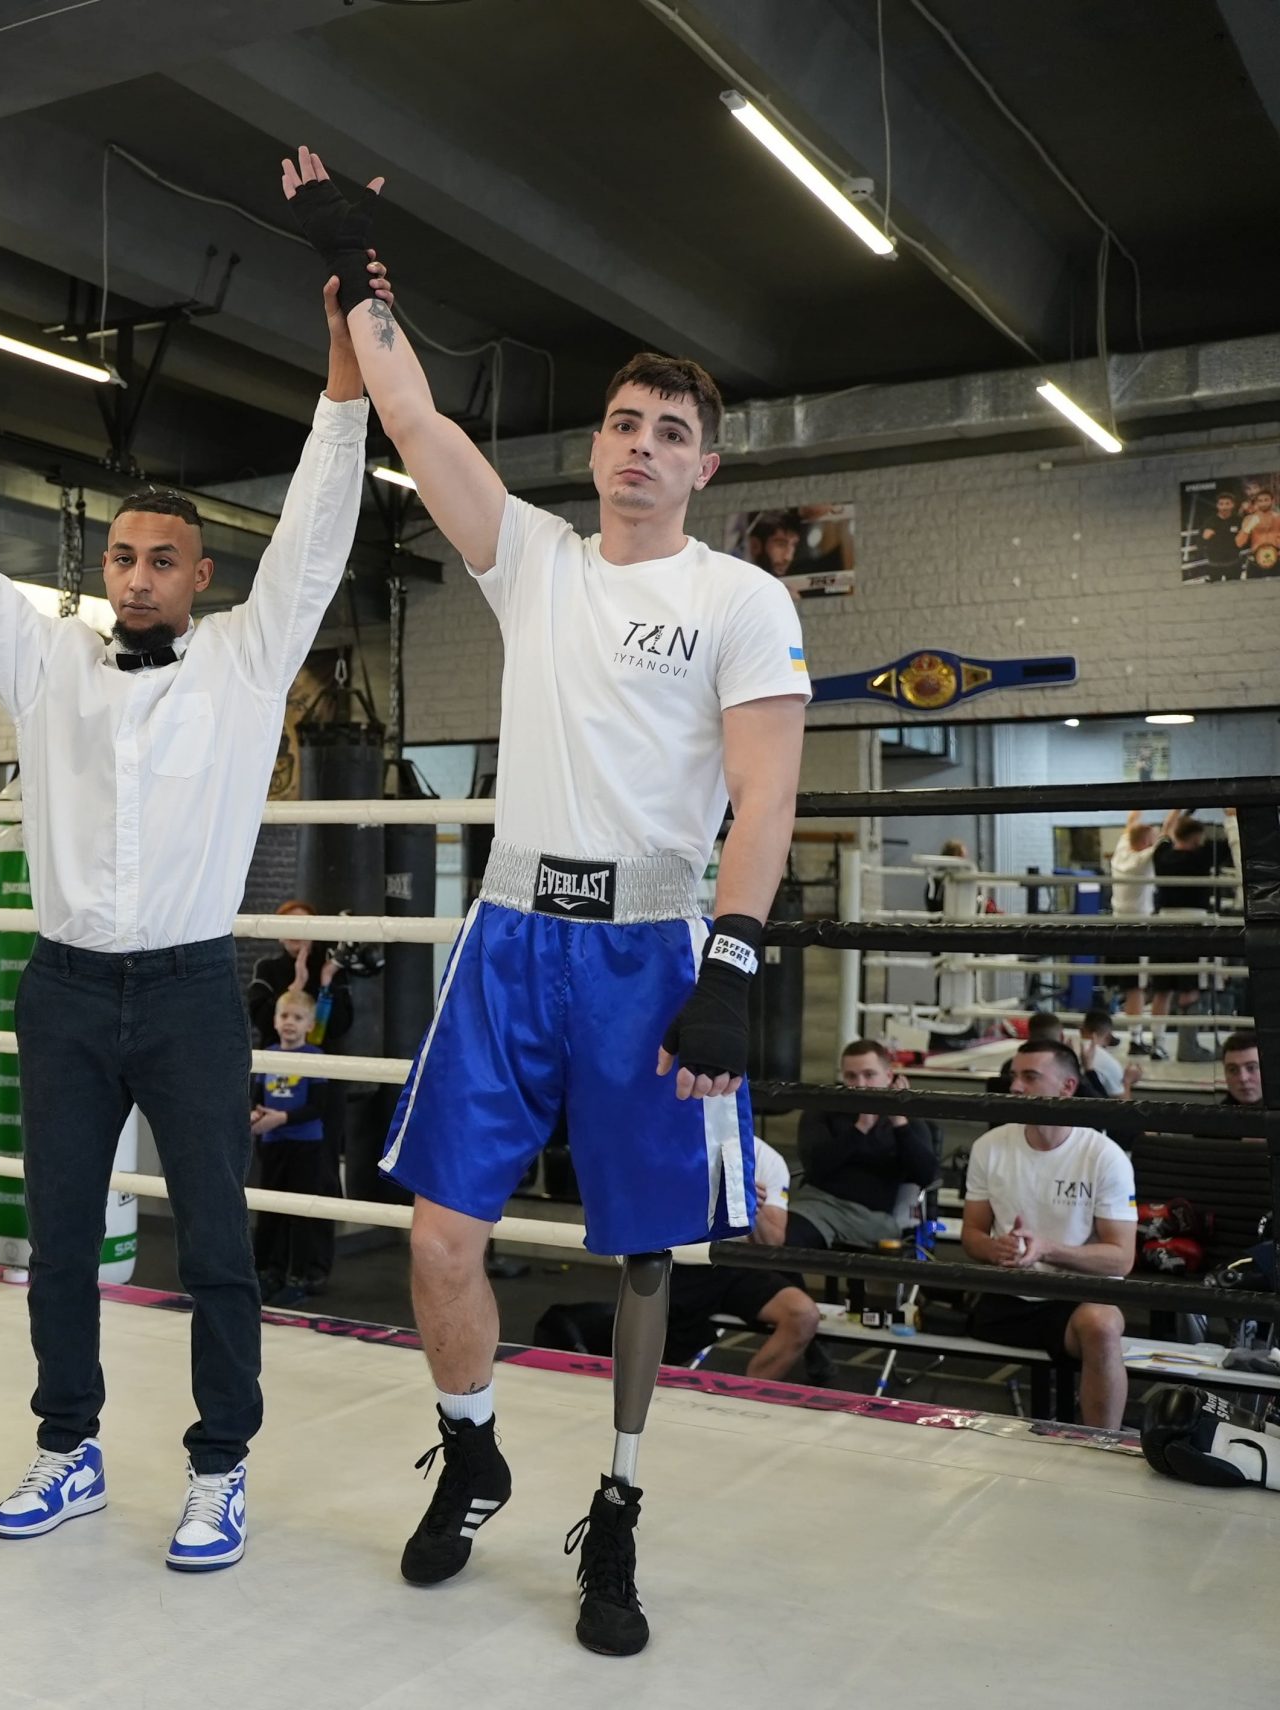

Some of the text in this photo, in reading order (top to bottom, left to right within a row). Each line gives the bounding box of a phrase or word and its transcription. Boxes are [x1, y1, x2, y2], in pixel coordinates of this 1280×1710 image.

[613, 652, 688, 678] TYTANOVI
[537, 863, 610, 905] EVERLAST
[714, 946, 749, 966] SPORT
[717, 938, 751, 957] PAFFEN
